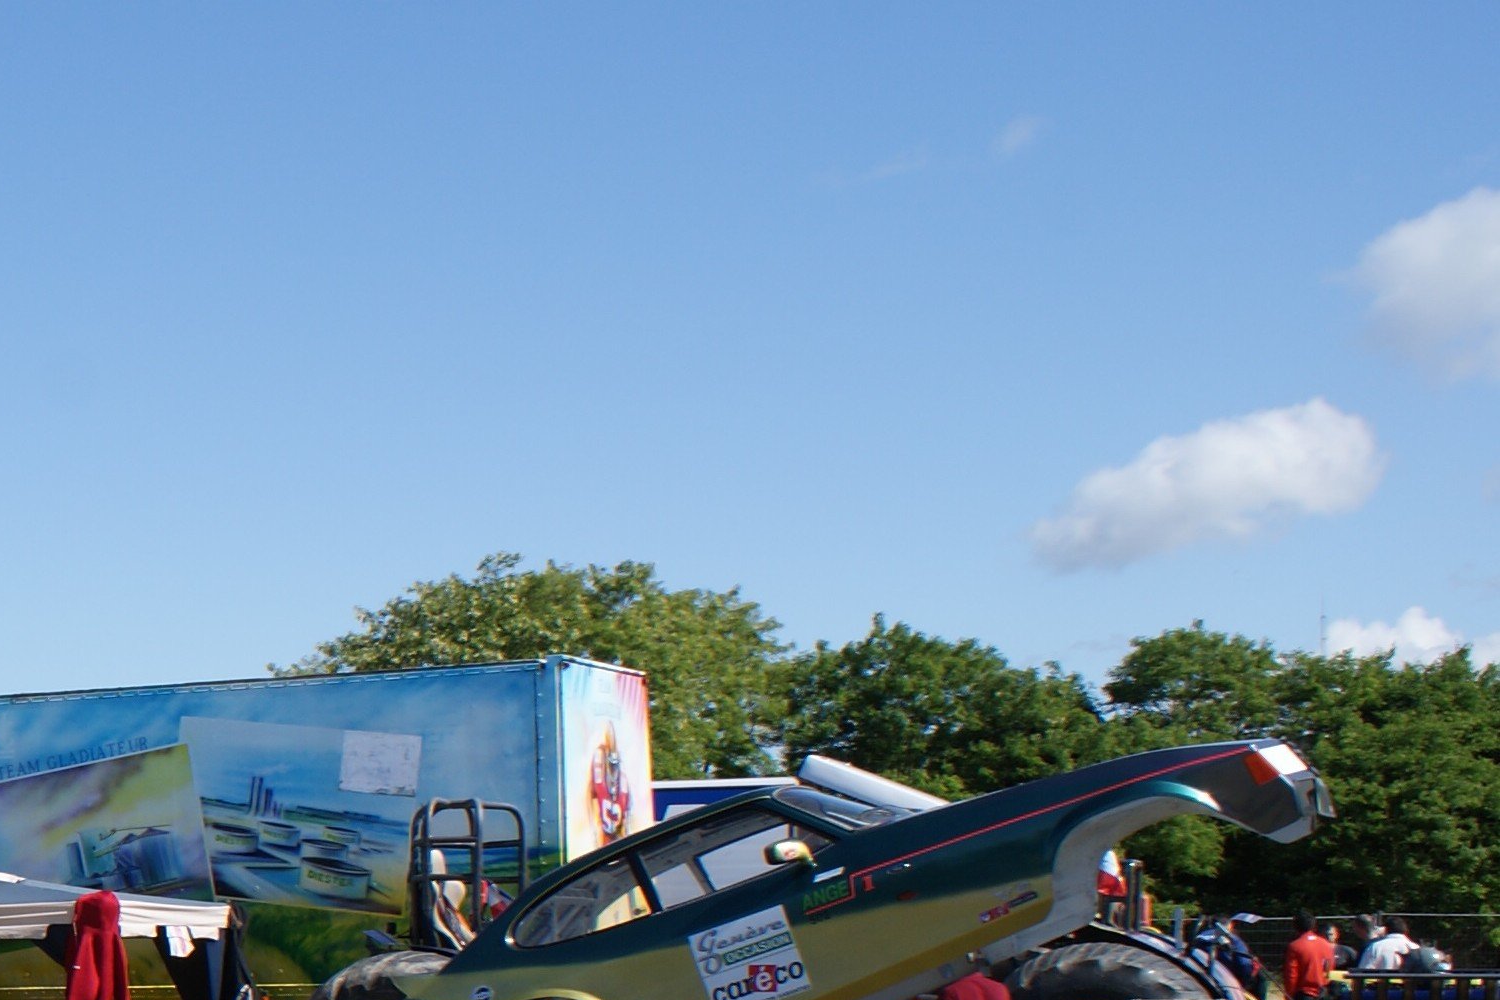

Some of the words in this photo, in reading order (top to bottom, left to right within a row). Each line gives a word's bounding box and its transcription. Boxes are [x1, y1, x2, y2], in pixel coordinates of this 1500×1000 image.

[46, 737, 148, 770] GLADIATEUR
[803, 880, 849, 909] ANGE
[697, 921, 785, 974] Genève
[724, 933, 791, 963] OCCASION
